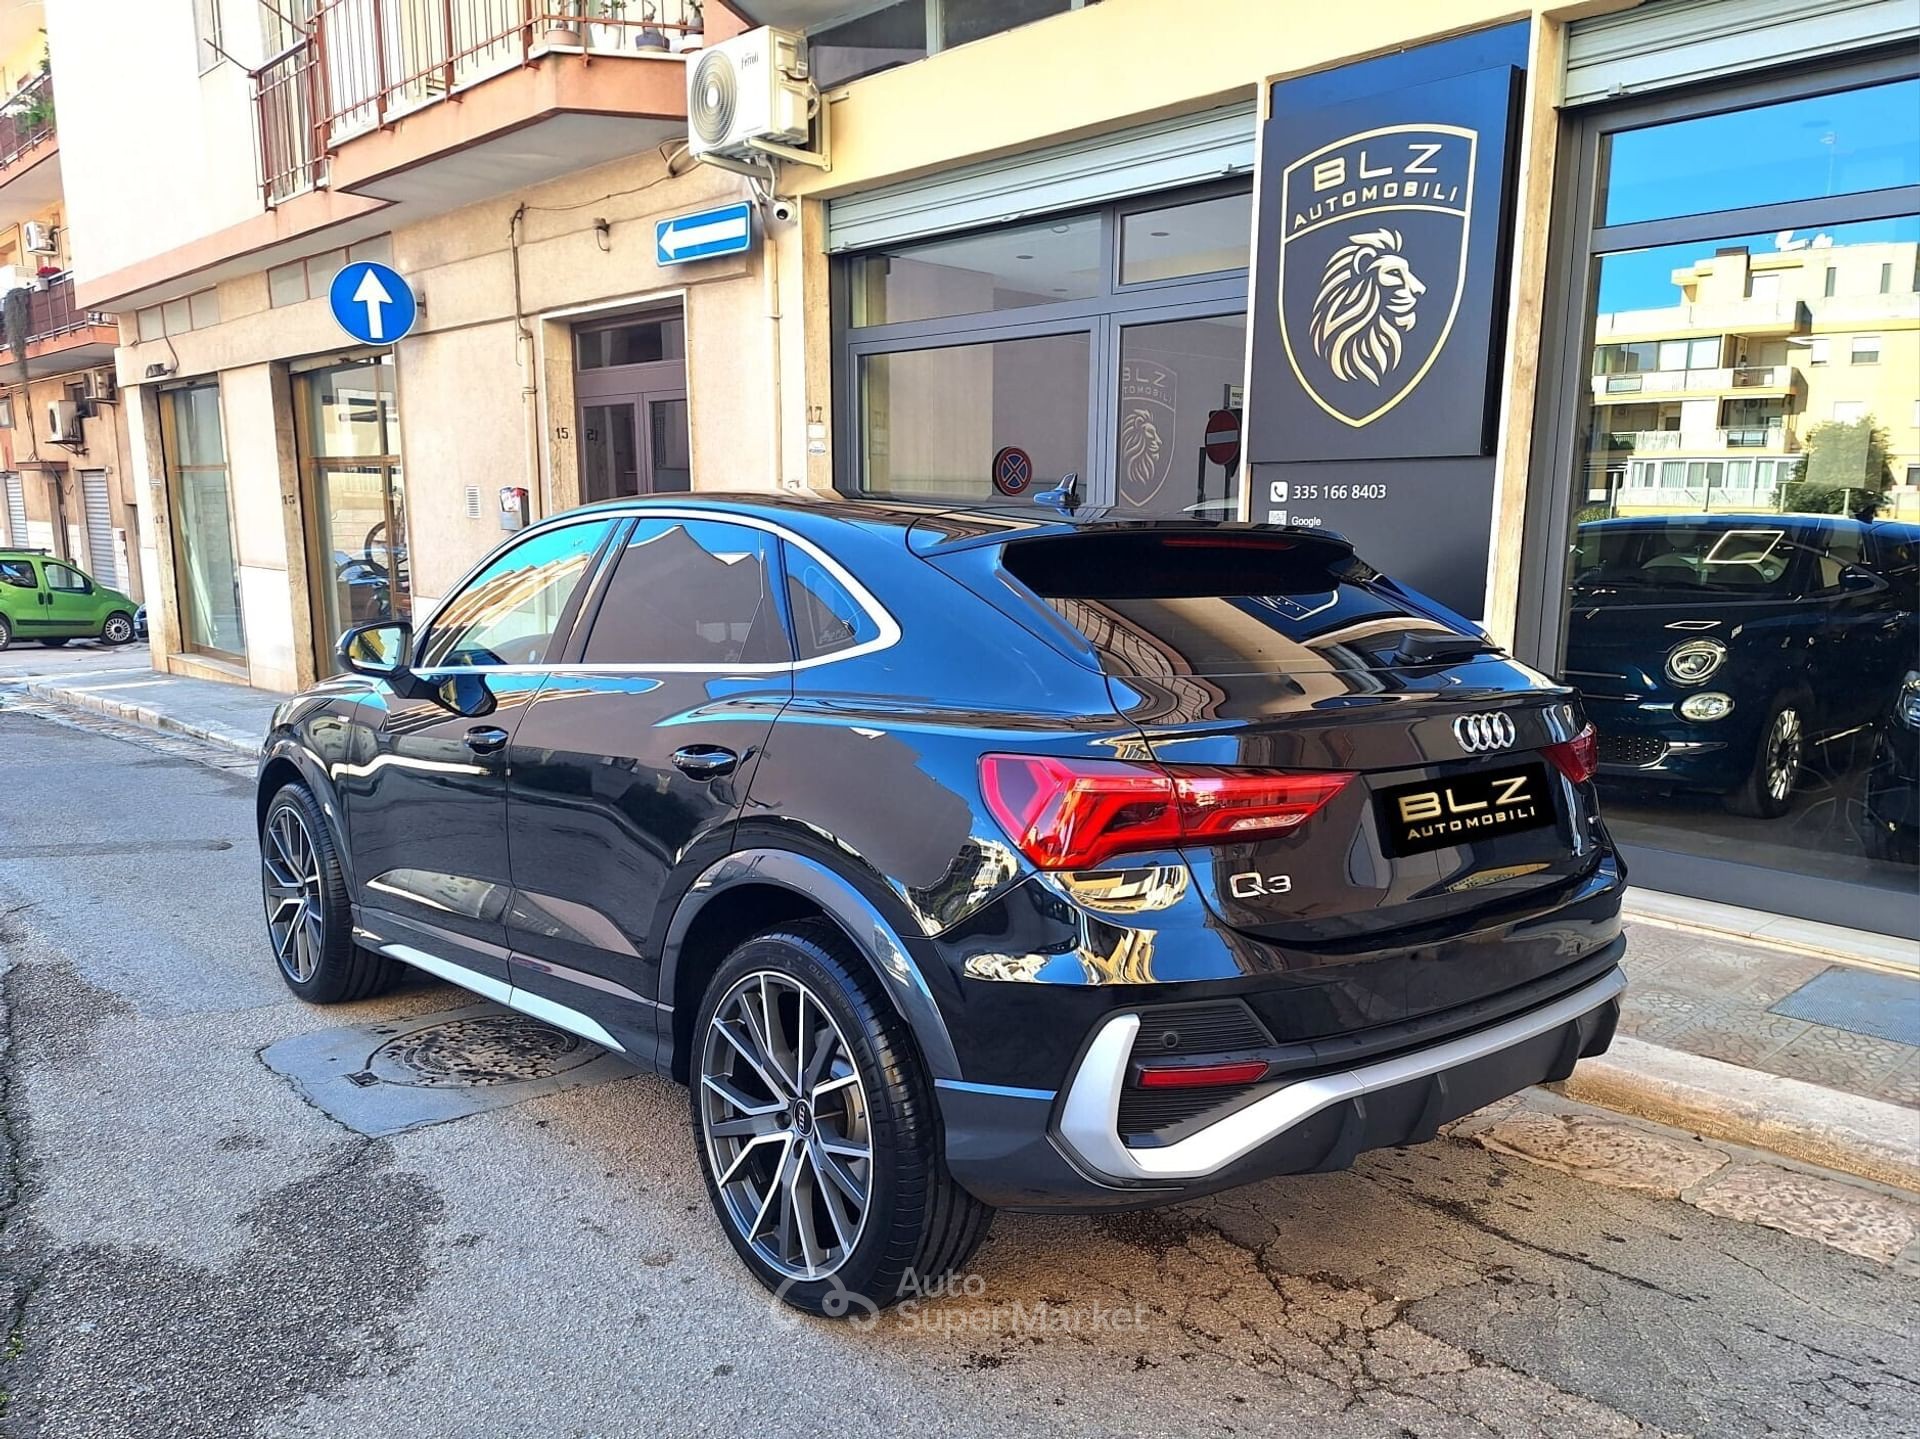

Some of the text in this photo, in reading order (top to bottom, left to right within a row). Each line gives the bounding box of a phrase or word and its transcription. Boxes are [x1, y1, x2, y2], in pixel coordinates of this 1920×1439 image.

[1313, 144, 1443, 192] BLZ
[1293, 181, 1459, 230] AUTOMOBILI
[1122, 385, 1172, 403] TOMOBILI
[556, 427, 569, 440] 15
[1293, 484, 1387, 499] 335 166 8403
[1291, 516, 1321, 528] Google
[1398, 776, 1532, 823] BLZ
[1407, 806, 1536, 840] AUTOMOBILI
[1230, 872, 1292, 898] Q3
